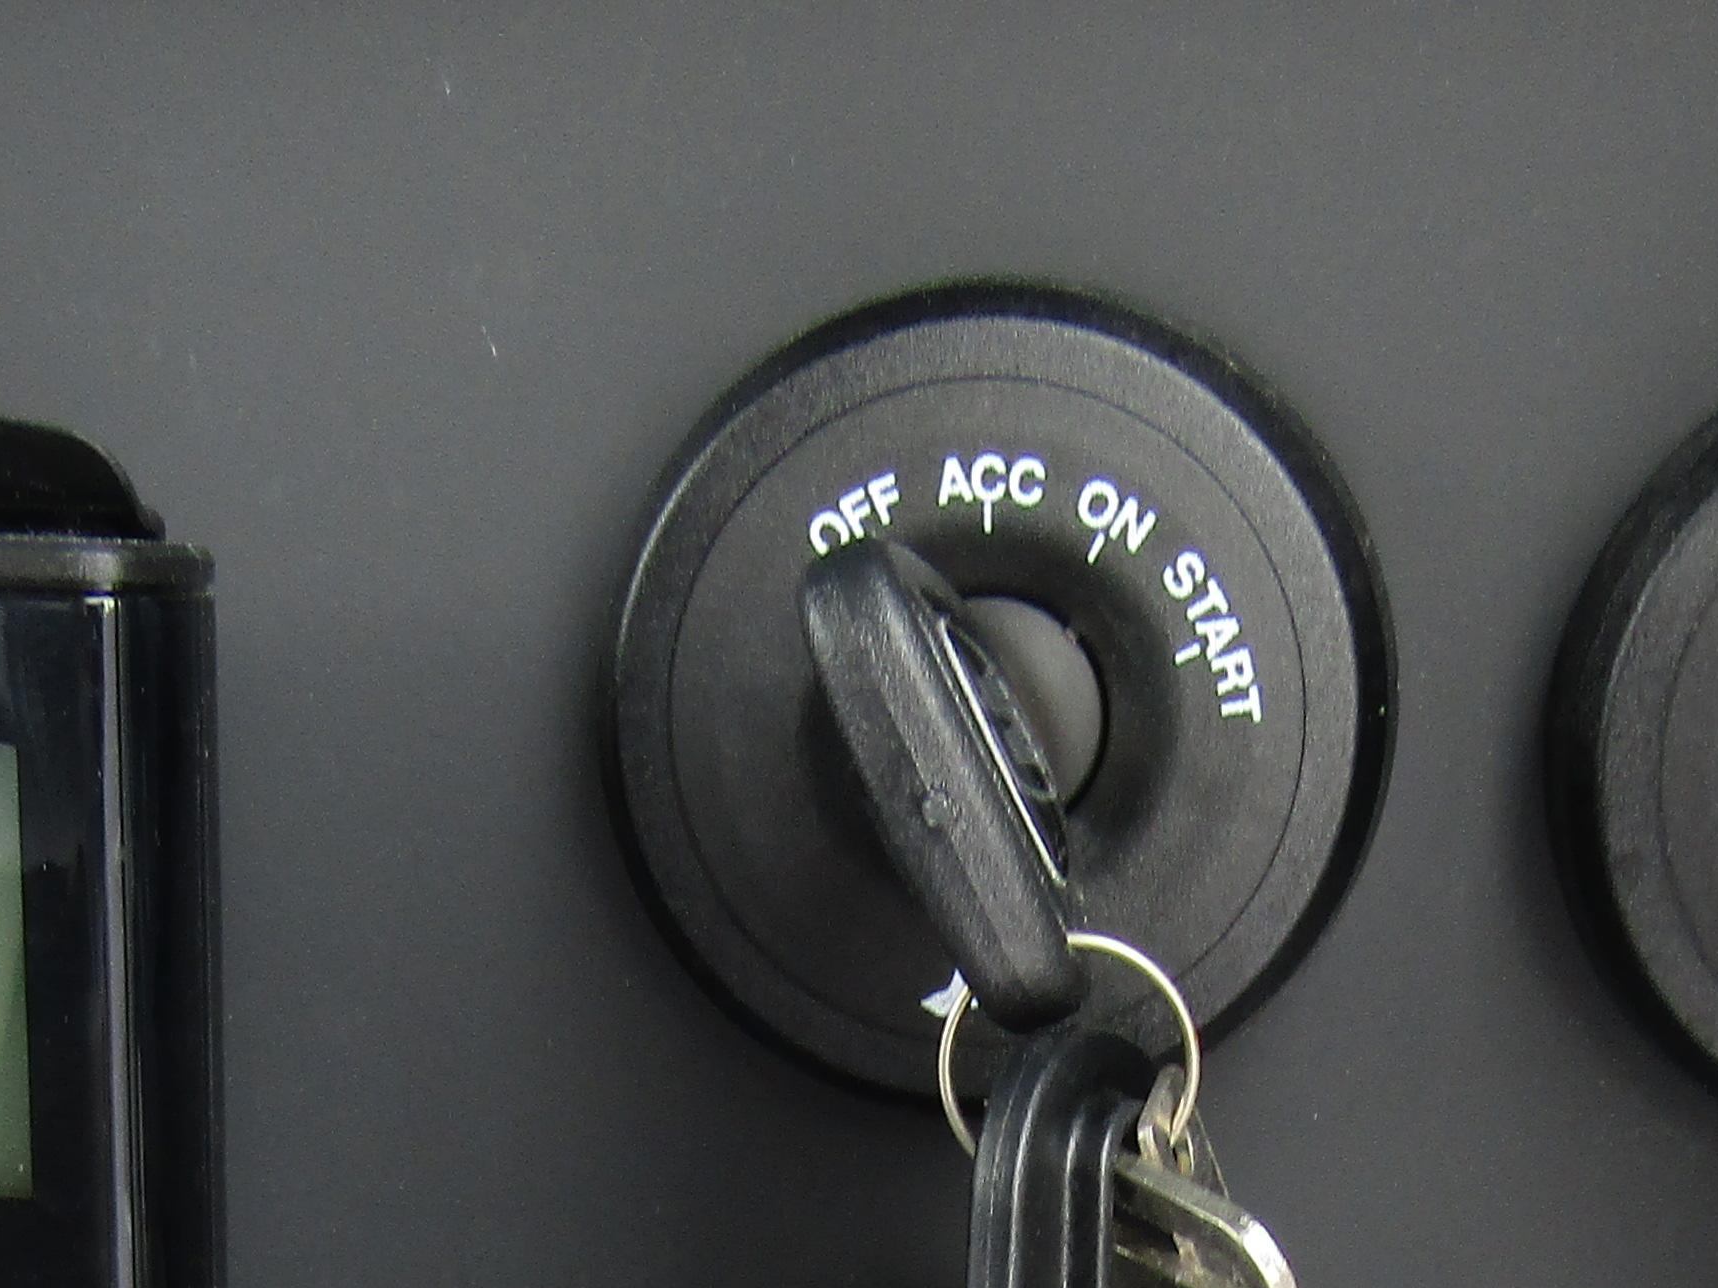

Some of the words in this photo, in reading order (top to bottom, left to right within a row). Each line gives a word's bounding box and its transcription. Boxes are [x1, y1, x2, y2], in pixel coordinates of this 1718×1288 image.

[808, 472, 901, 556] OFF
[937, 452, 1047, 508] ACC
[1077, 479, 1158, 555] ON
[1162, 550, 1263, 724] START
